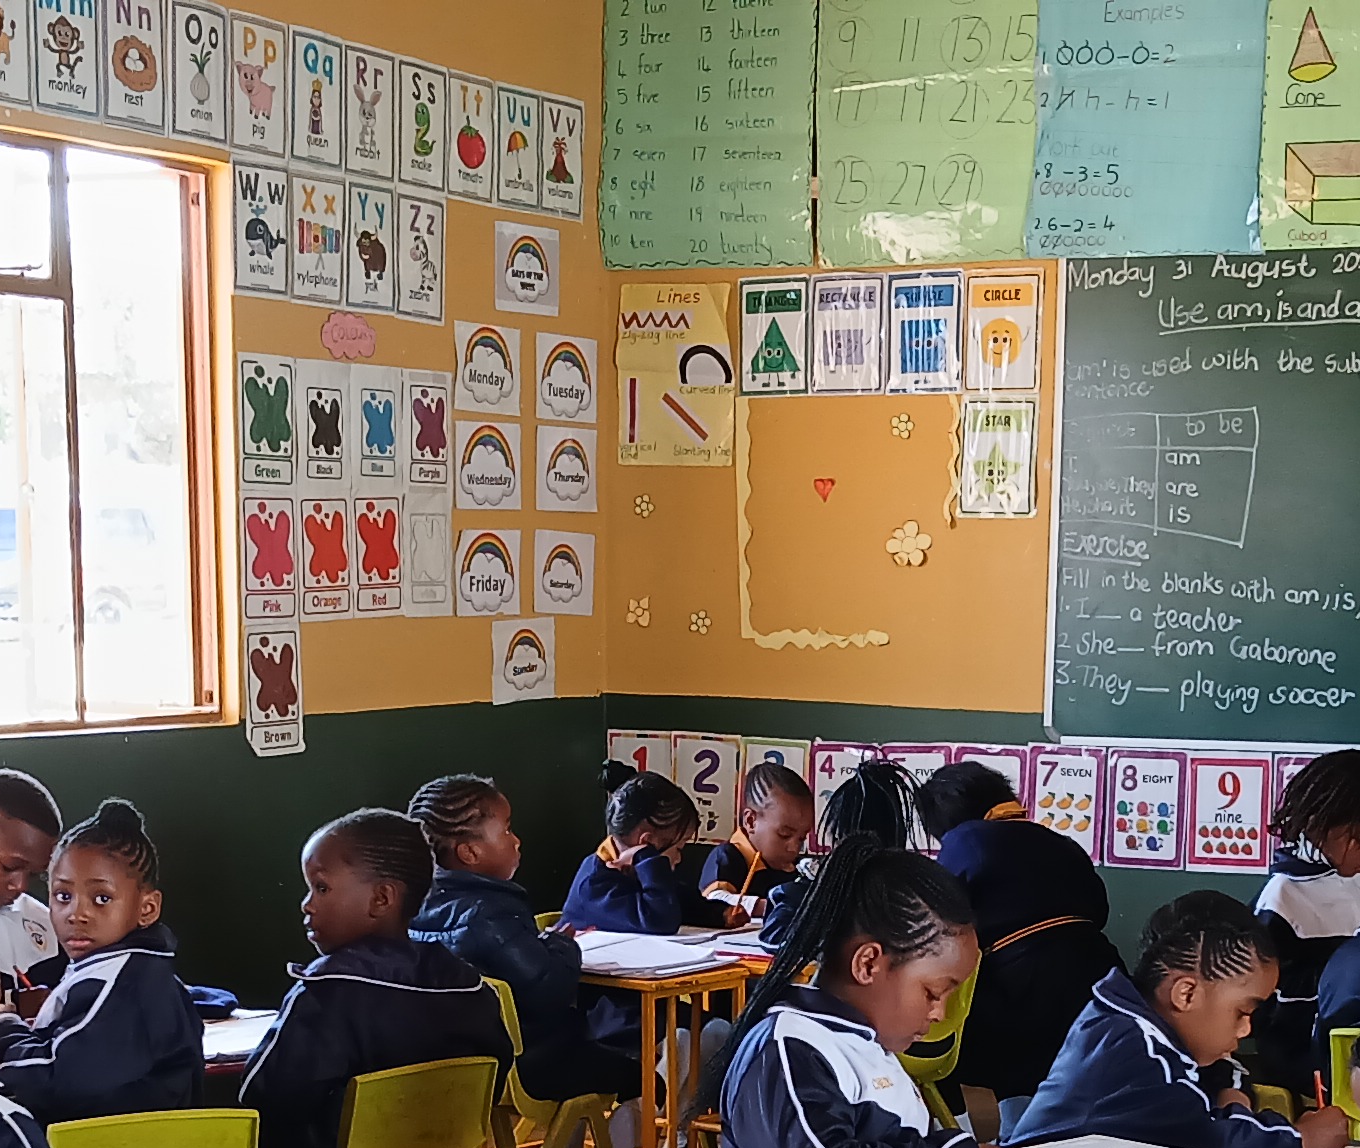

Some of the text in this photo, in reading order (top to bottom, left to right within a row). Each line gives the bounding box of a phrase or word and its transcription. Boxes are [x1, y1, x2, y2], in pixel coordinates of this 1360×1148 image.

[1104, 0, 1185, 23] Examples
[48, 79, 87, 98] monkey
[1286, 84, 1325, 106] Cone
[251, 122, 265, 139] pig
[887, 164, 926, 206] 27
[1068, 259, 1155, 298] Monday
[1171, 259, 1193, 281] 31
[1211, 254, 1317, 288] August
[984, 289, 1020, 302] CIRCLE
[1158, 295, 1209, 328] Use
[1216, 302, 1270, 323] am,
[1276, 289, 1293, 321] is
[1296, 290, 1340, 319] and
[1141, 348, 1192, 376] used
[1201, 347, 1260, 372] with
[1277, 349, 1315, 374] the
[468, 369, 505, 389] Monday
[547, 382, 585, 400] Tuesday
[1185, 413, 1243, 436] to be
[1165, 452, 1200, 465] am
[254, 464, 280, 479] Green
[467, 473, 511, 488] Wednesday
[1165, 481, 1199, 497] are
[1169, 504, 1191, 523] is
[1063, 531, 1150, 559] Exercise
[469, 575, 506, 596] Friday
[1062, 568, 1089, 588] Fill
[1101, 571, 1116, 588] in
[1122, 570, 1151, 592] the
[1162, 572, 1224, 594] blanks
[1230, 577, 1275, 602] with
[312, 595, 341, 609] Orange
[372, 594, 386, 606] Red
[1130, 607, 1142, 622] a
[1153, 604, 1242, 632] teacher
[1076, 630, 1337, 673] She from Gaborone
[1180, 670, 1259, 713] playing
[1268, 685, 1356, 707] soccer
[693, 749, 720, 794] 2
[1039, 760, 1093, 787] 7 SEVEN
[1120, 764, 1174, 792] 8 EIGHT
[1217, 771, 1242, 811] 9
[1214, 810, 1243, 824] nine
